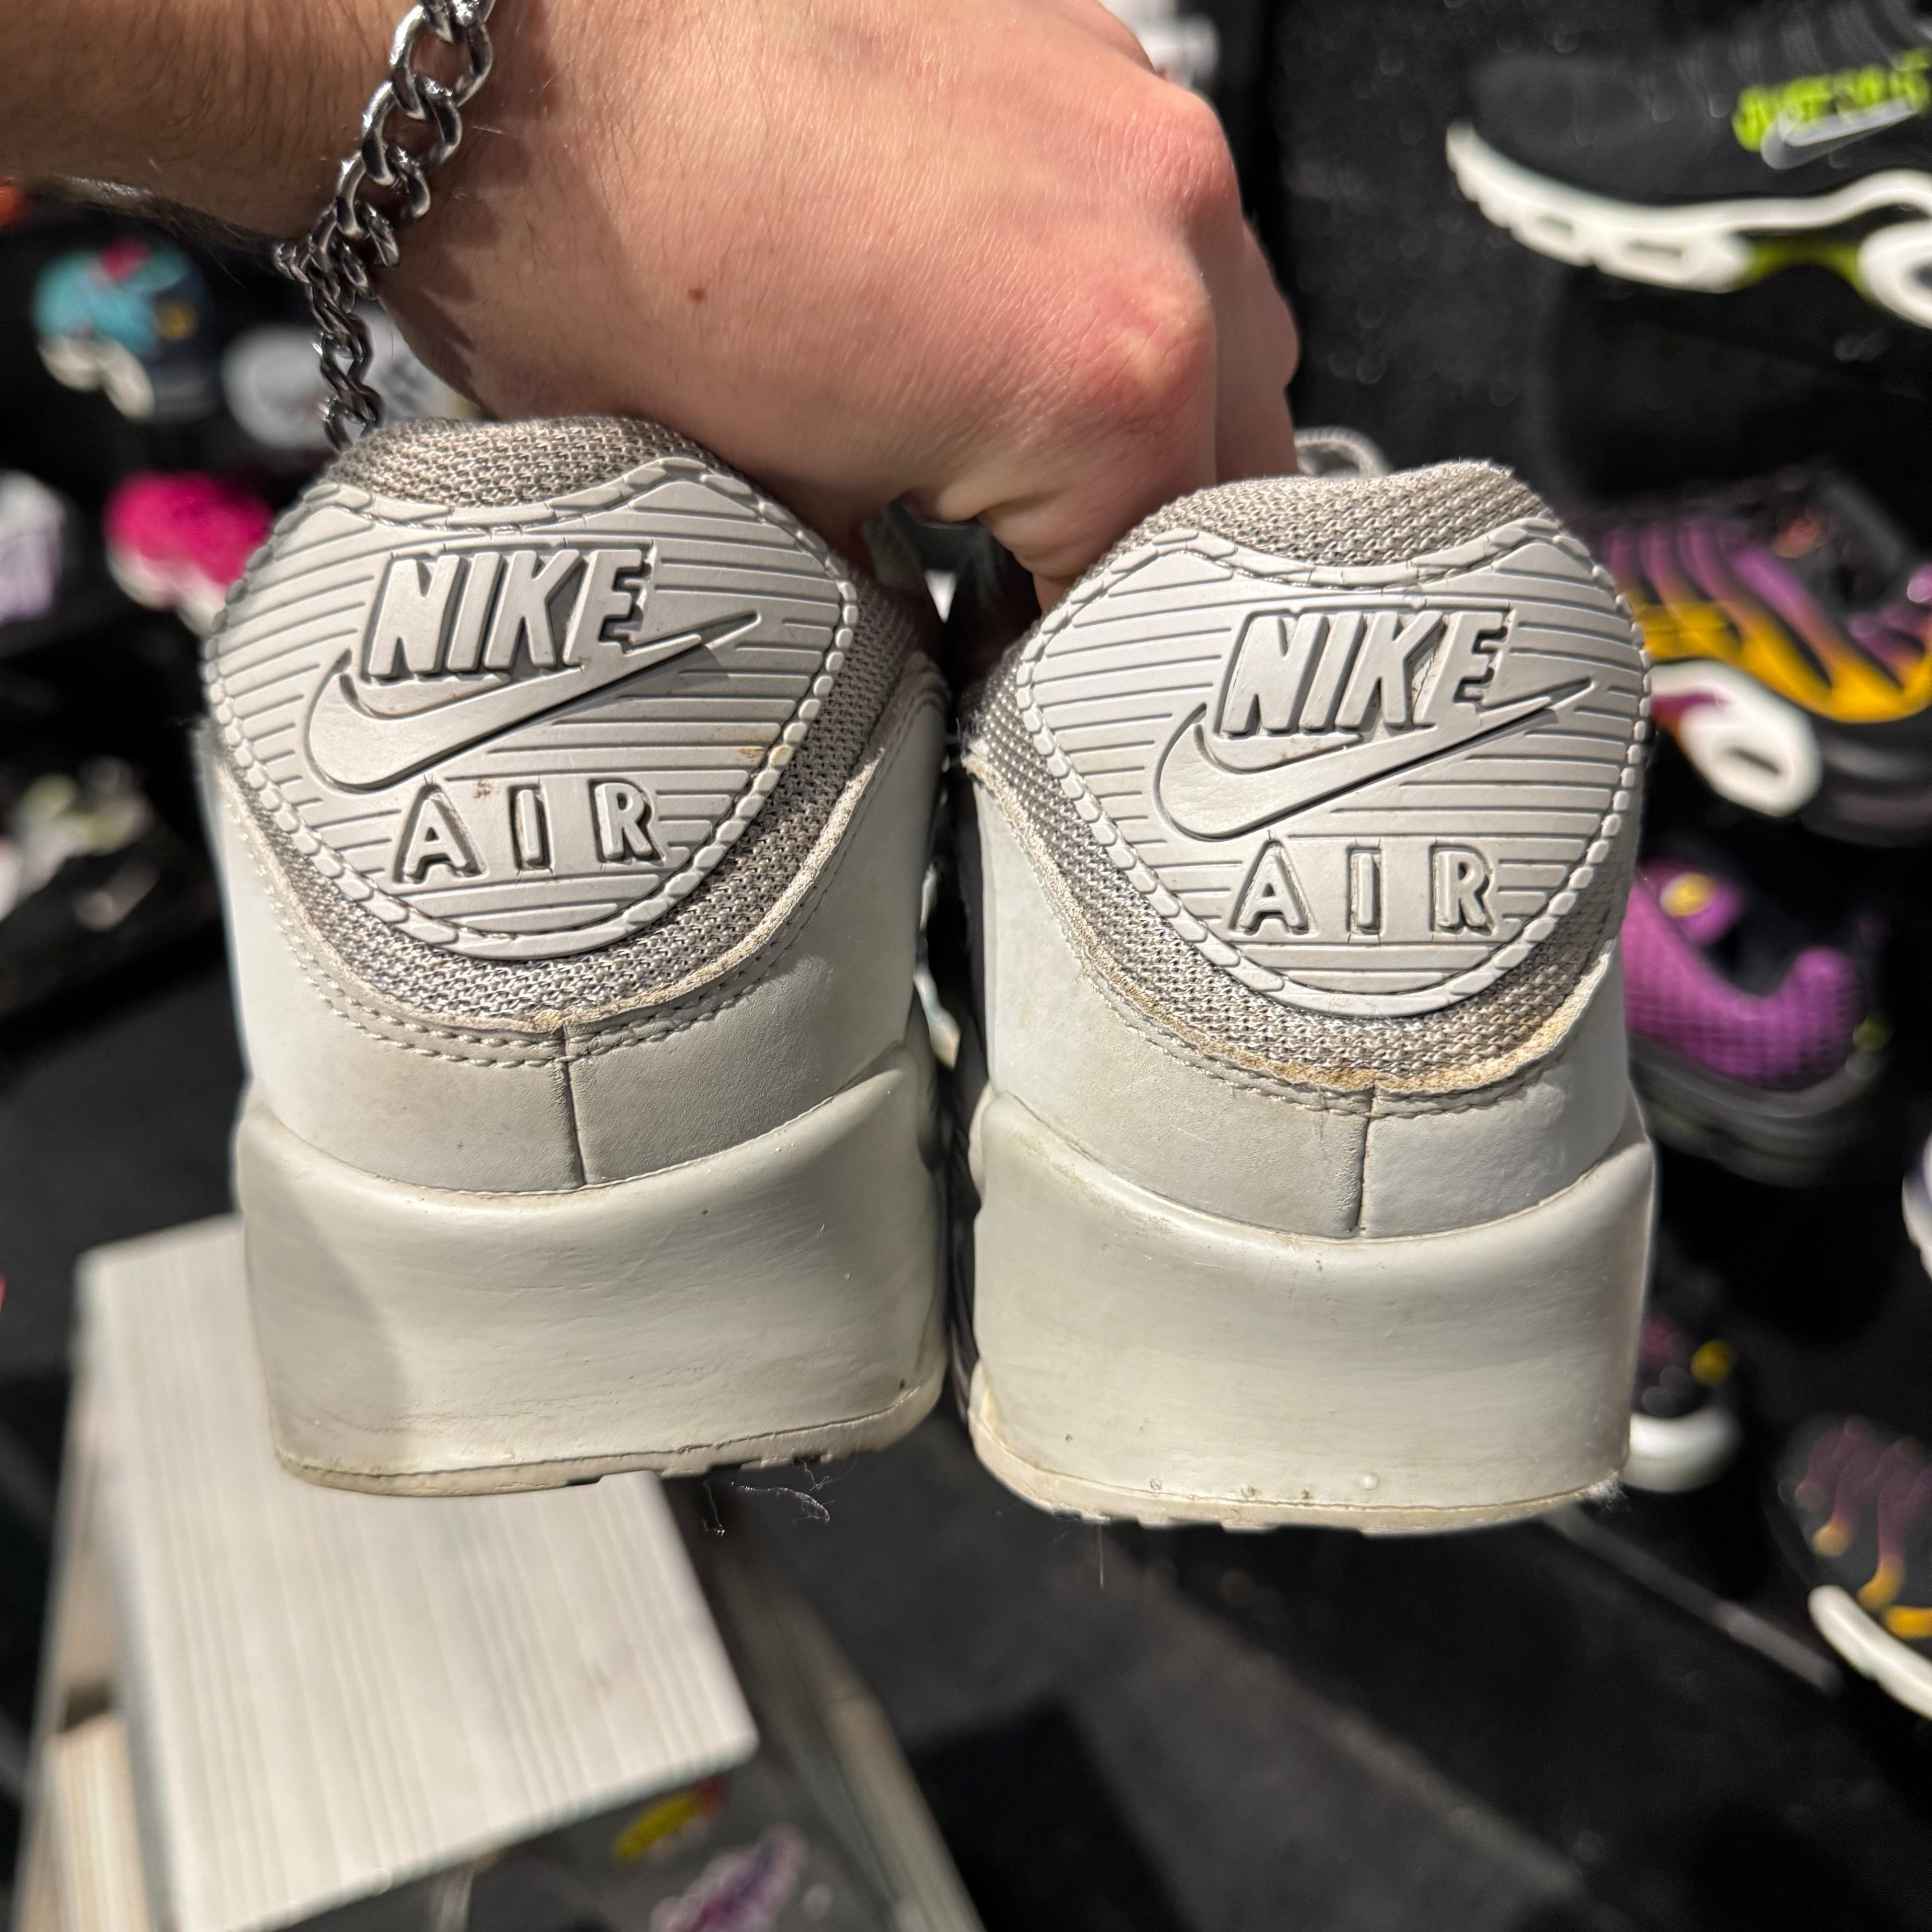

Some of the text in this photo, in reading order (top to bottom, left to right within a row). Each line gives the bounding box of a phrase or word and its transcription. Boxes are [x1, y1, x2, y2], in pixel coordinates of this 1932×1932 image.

[368, 548, 645, 677] NIKE
[1221, 610, 1504, 733] NIKE
[402, 780, 655, 878] AIR
[1237, 847, 1490, 931] AIR
